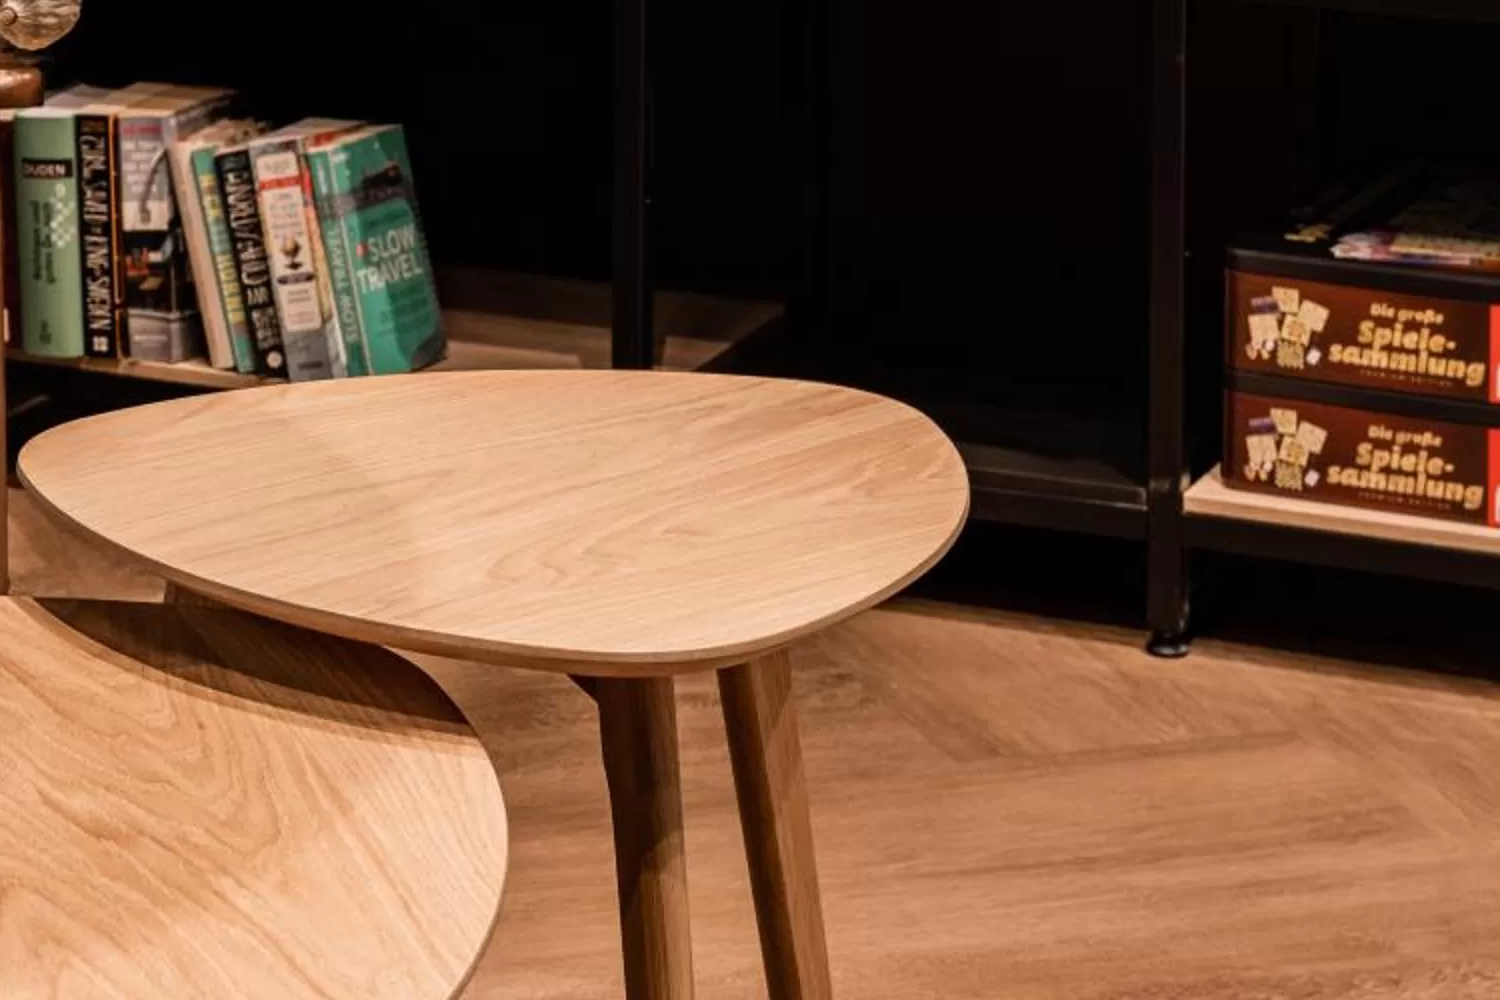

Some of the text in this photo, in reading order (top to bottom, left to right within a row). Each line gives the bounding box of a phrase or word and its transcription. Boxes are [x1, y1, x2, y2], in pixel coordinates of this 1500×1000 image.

[23, 163, 66, 178] DUDEN
[368, 222, 416, 262] SLOW
[327, 229, 359, 344] SLOW TRAVEL
[356, 253, 424, 294] TRAVEL
[87, 276, 112, 331] SWEDEN
[1370, 302, 1444, 325] Die große
[1357, 319, 1457, 353] Spiele-
[1328, 343, 1485, 388] sammlung
[1367, 424, 1443, 448] Die große
[1355, 441, 1455, 476] Spiele-
[1326, 464, 1484, 511] sammlung
